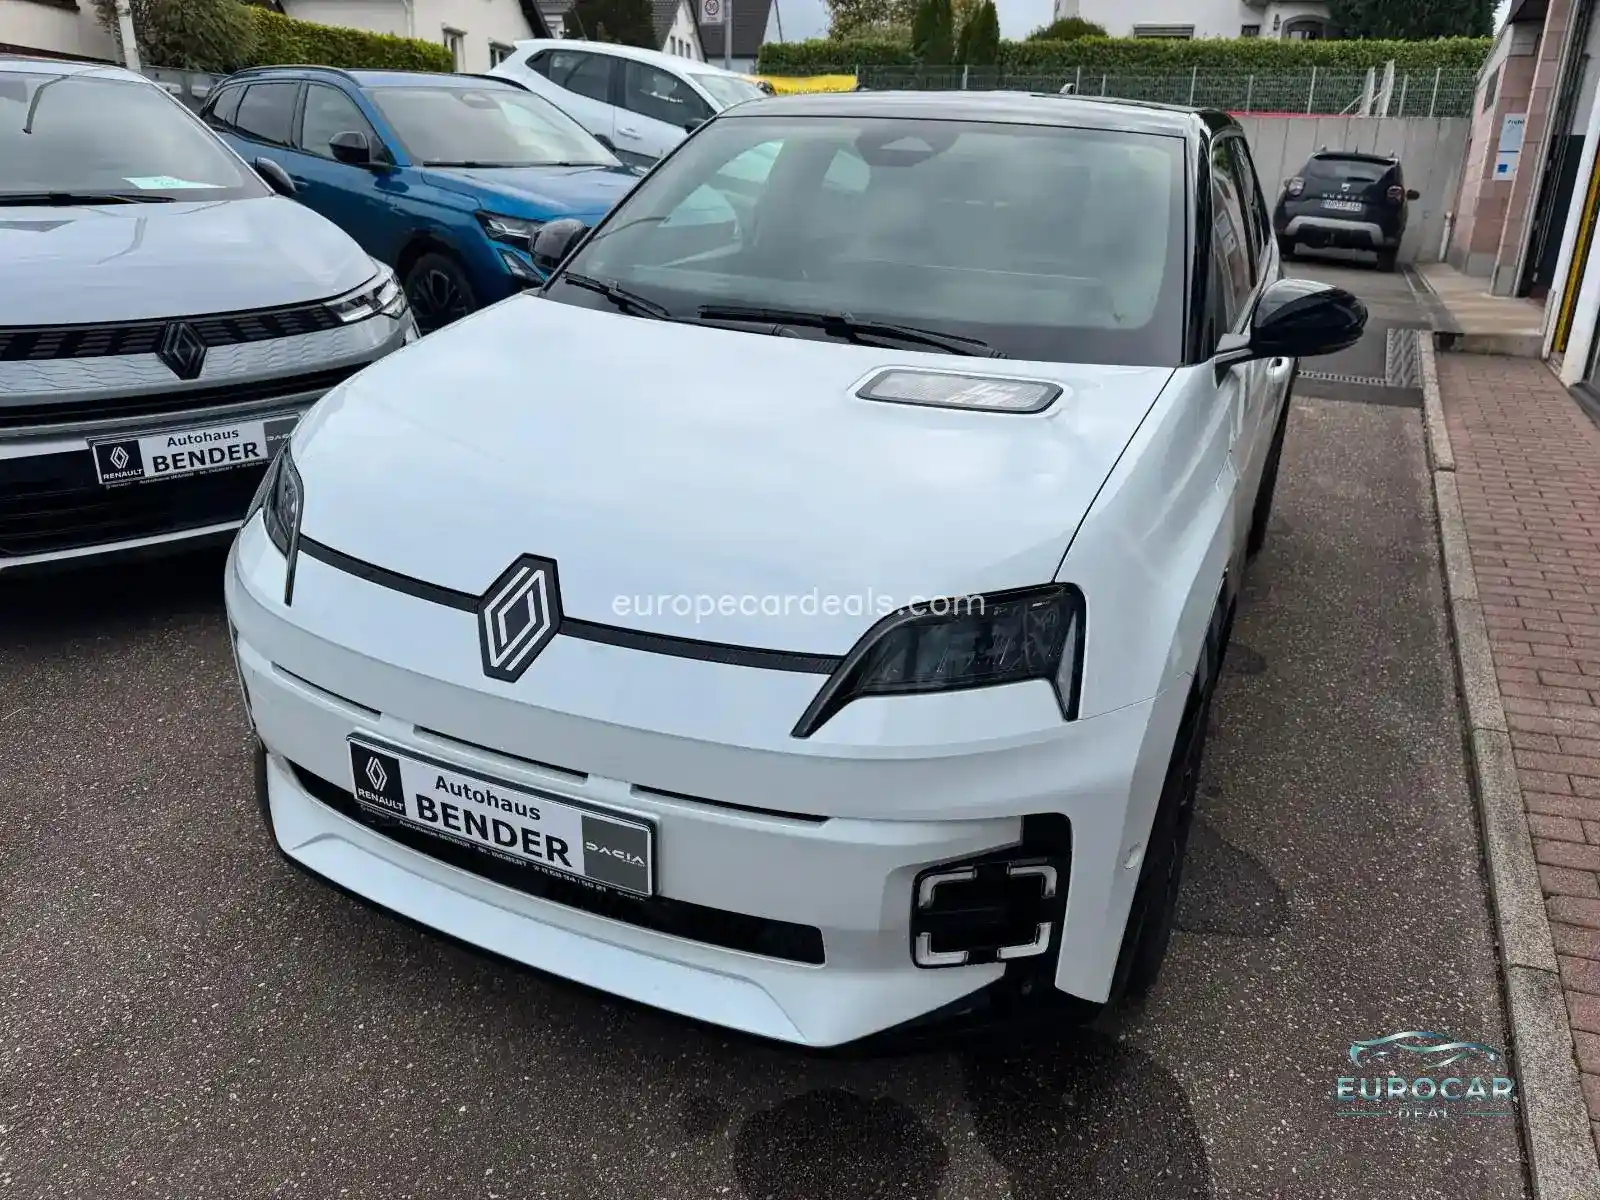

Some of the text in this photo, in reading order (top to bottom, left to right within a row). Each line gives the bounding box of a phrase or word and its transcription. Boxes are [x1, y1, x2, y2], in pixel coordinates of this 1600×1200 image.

[167, 429, 239, 448] Autohaus
[152, 442, 260, 473] BENDER
[103, 468, 144, 480] RENAULT
[357, 787, 404, 811] RENAULT
[435, 775, 540, 821] Autohaus
[415, 793, 573, 868] BENDER
[585, 841, 646, 866] DACIA
